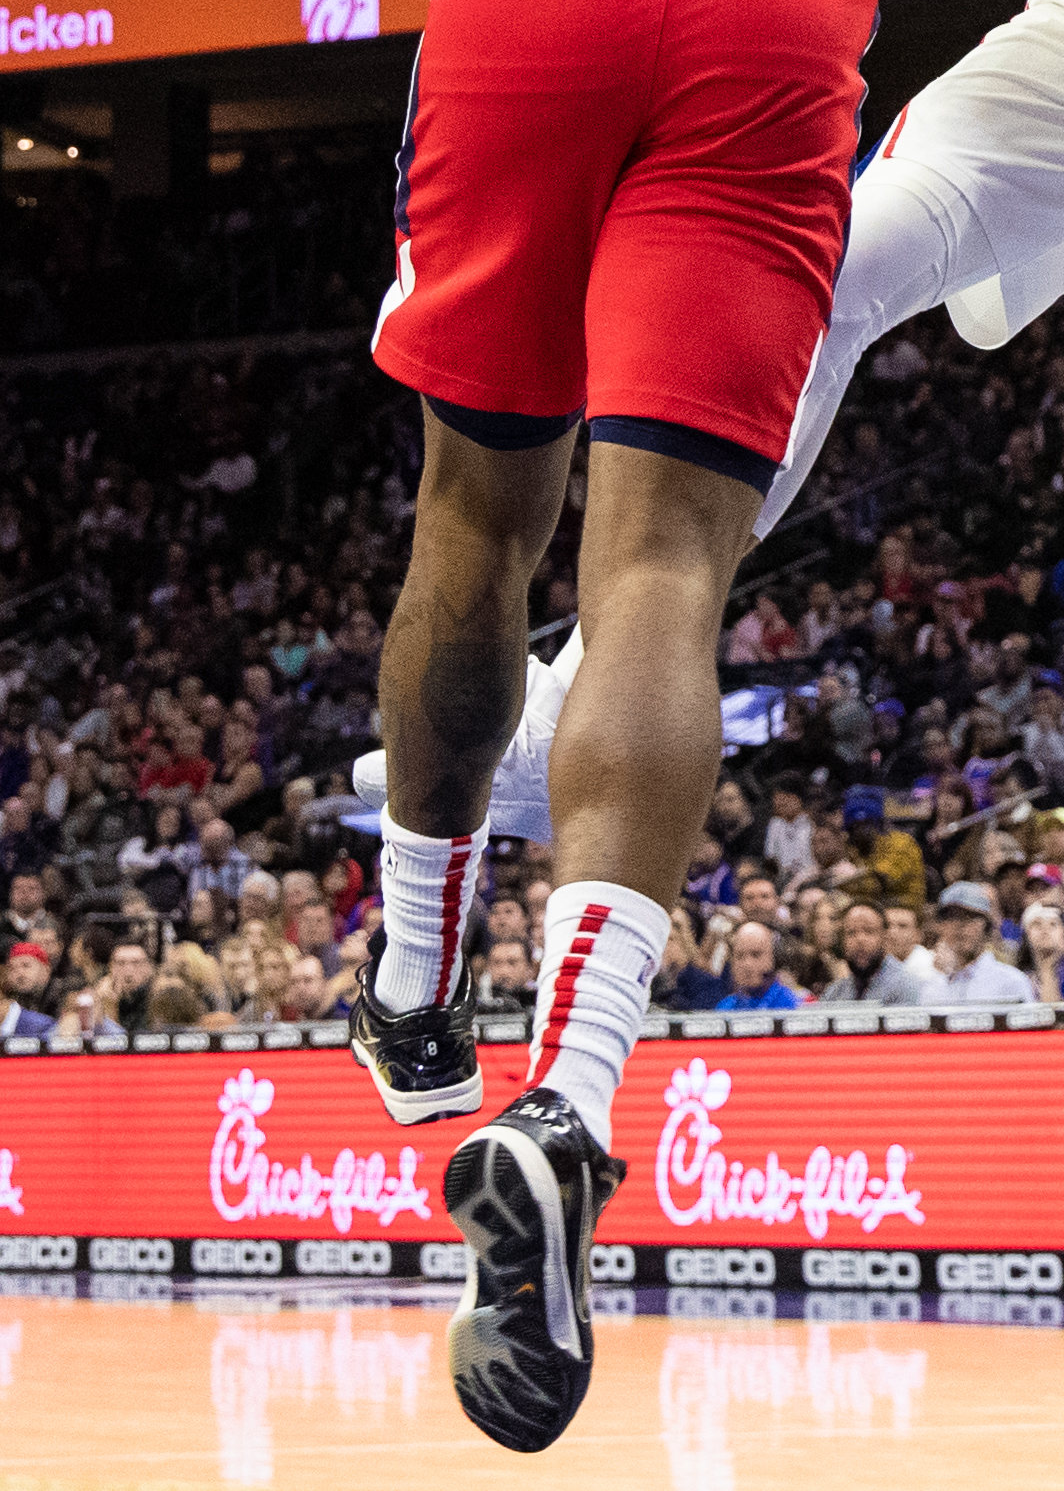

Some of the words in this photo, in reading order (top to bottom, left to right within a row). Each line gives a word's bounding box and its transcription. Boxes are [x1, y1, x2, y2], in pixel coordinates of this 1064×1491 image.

[210, 1106, 432, 1233] Chick-fil-A
[655, 1099, 926, 1240] Chick-fil-A
[89, 1237, 174, 1273] GEICO
[191, 1238, 283, 1275] GEICO
[295, 1239, 392, 1276] GEICO
[666, 1248, 776, 1286] GEICO
[802, 1249, 922, 1290] GEICO
[936, 1251, 1063, 1292] GEICO
